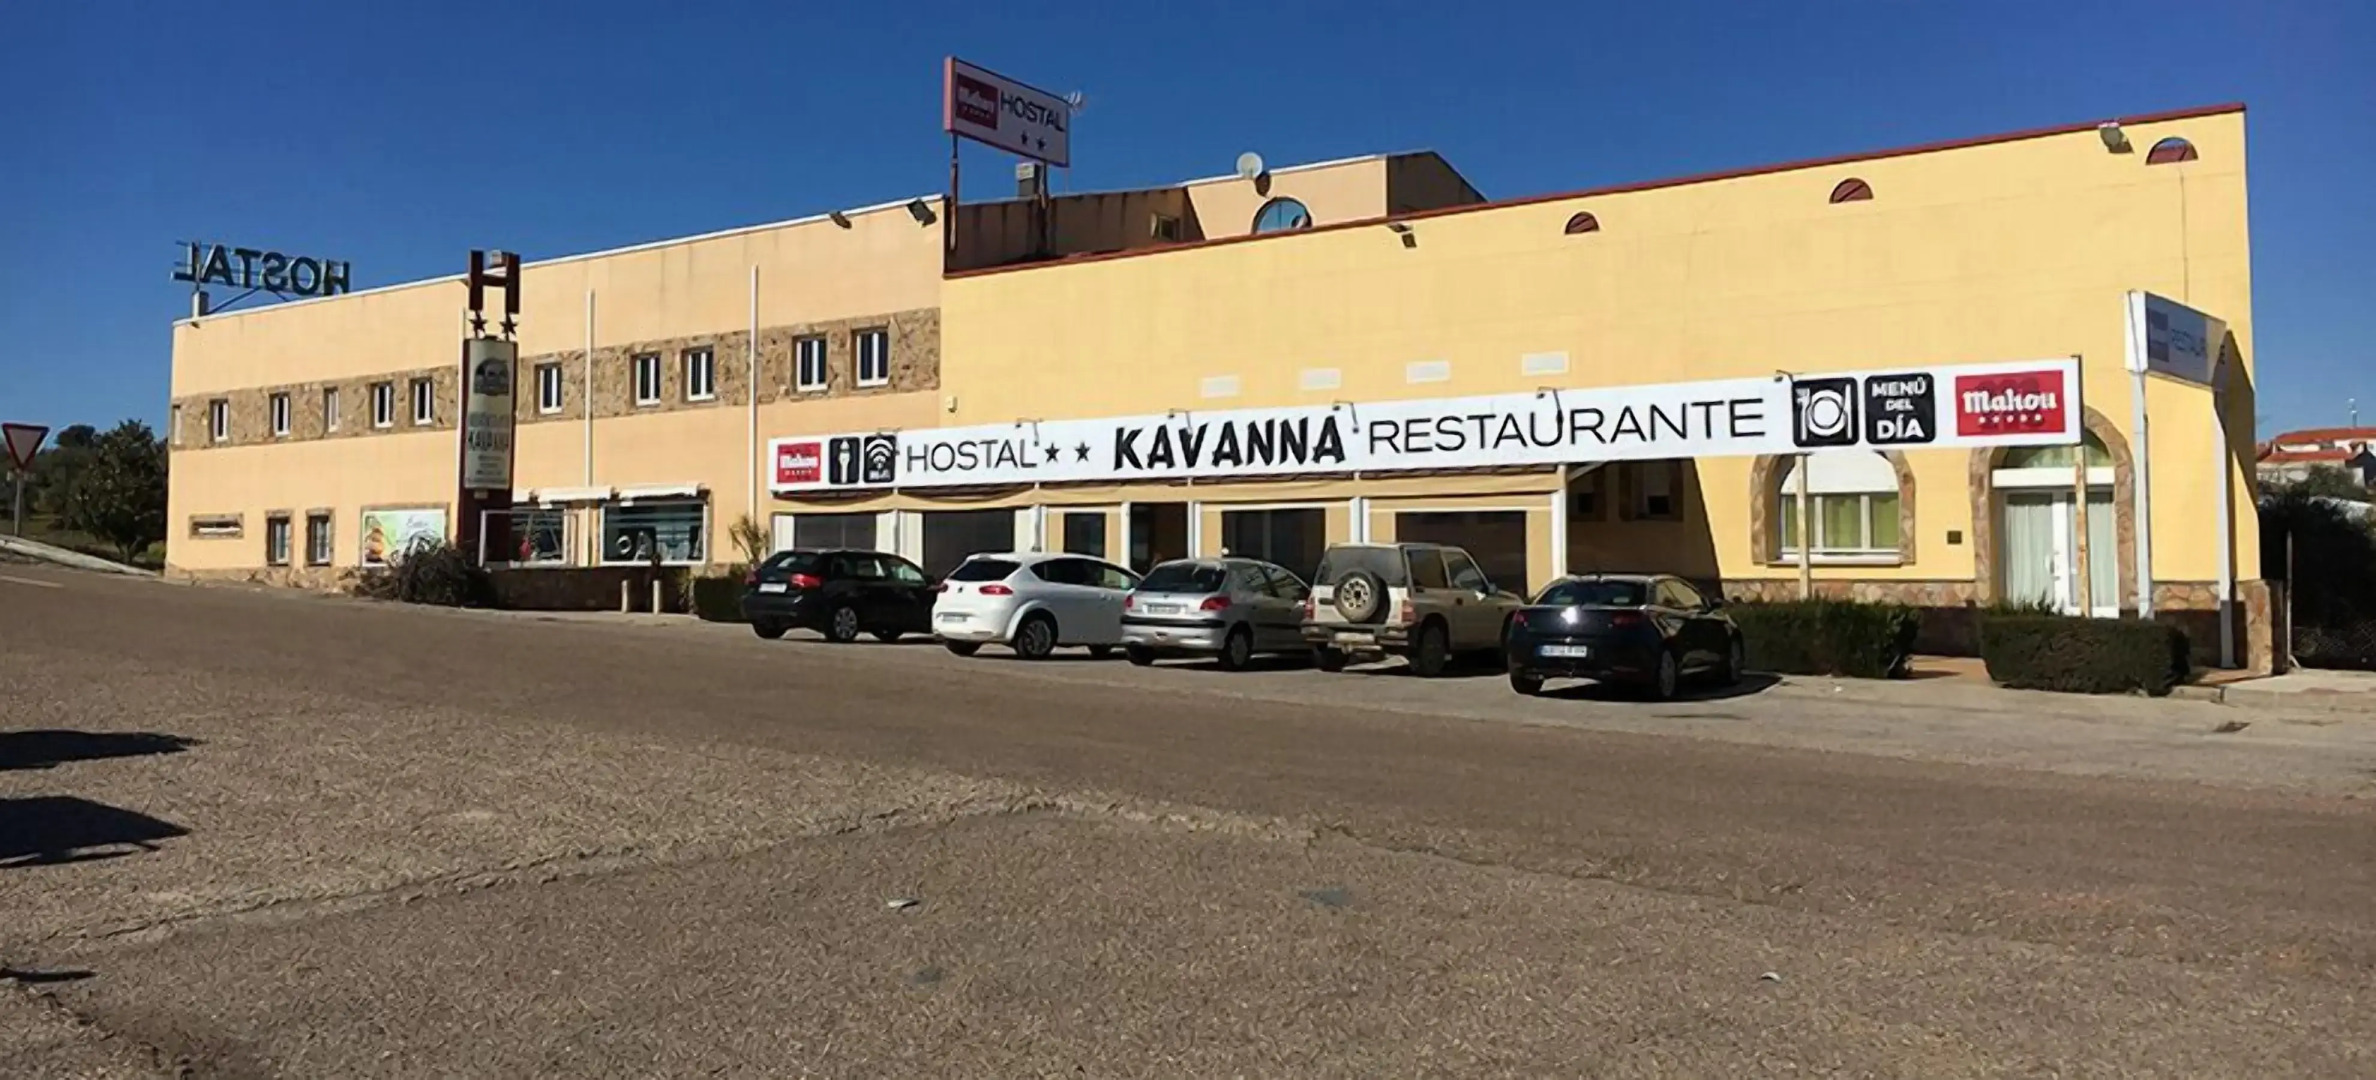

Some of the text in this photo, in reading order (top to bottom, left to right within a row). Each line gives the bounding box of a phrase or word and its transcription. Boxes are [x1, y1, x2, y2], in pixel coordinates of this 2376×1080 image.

[1001, 90, 1065, 132] HOSTAL
[469, 249, 520, 314] H
[1872, 377, 1926, 397] MENÚ
[1885, 398, 1914, 411] DEL
[1963, 388, 2057, 414] Mahou
[907, 398, 1766, 472] HOSTAL KAVANNA RESTAURANTE
[1877, 414, 1925, 439] DÍA
